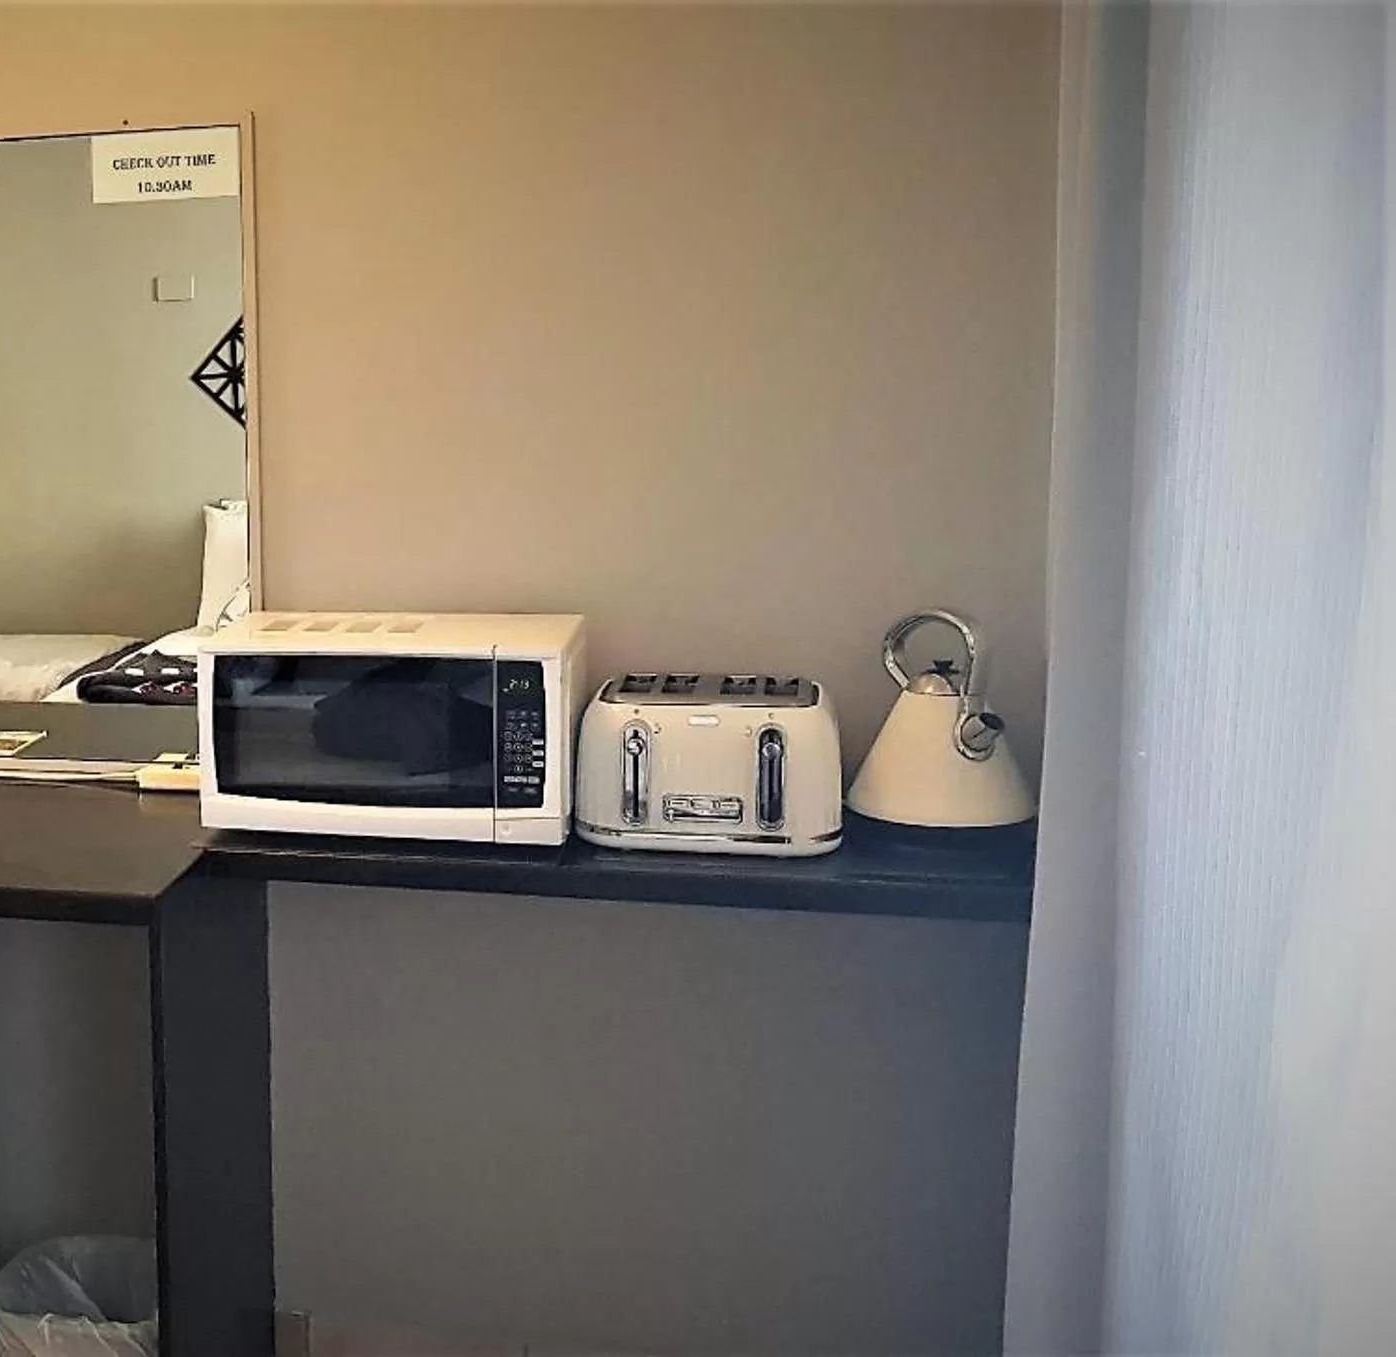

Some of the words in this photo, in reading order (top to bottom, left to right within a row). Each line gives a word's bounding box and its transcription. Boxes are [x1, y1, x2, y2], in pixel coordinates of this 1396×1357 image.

[112, 157, 154, 170] CHECK
[155, 155, 182, 168] OUT
[184, 153, 216, 166] TIME
